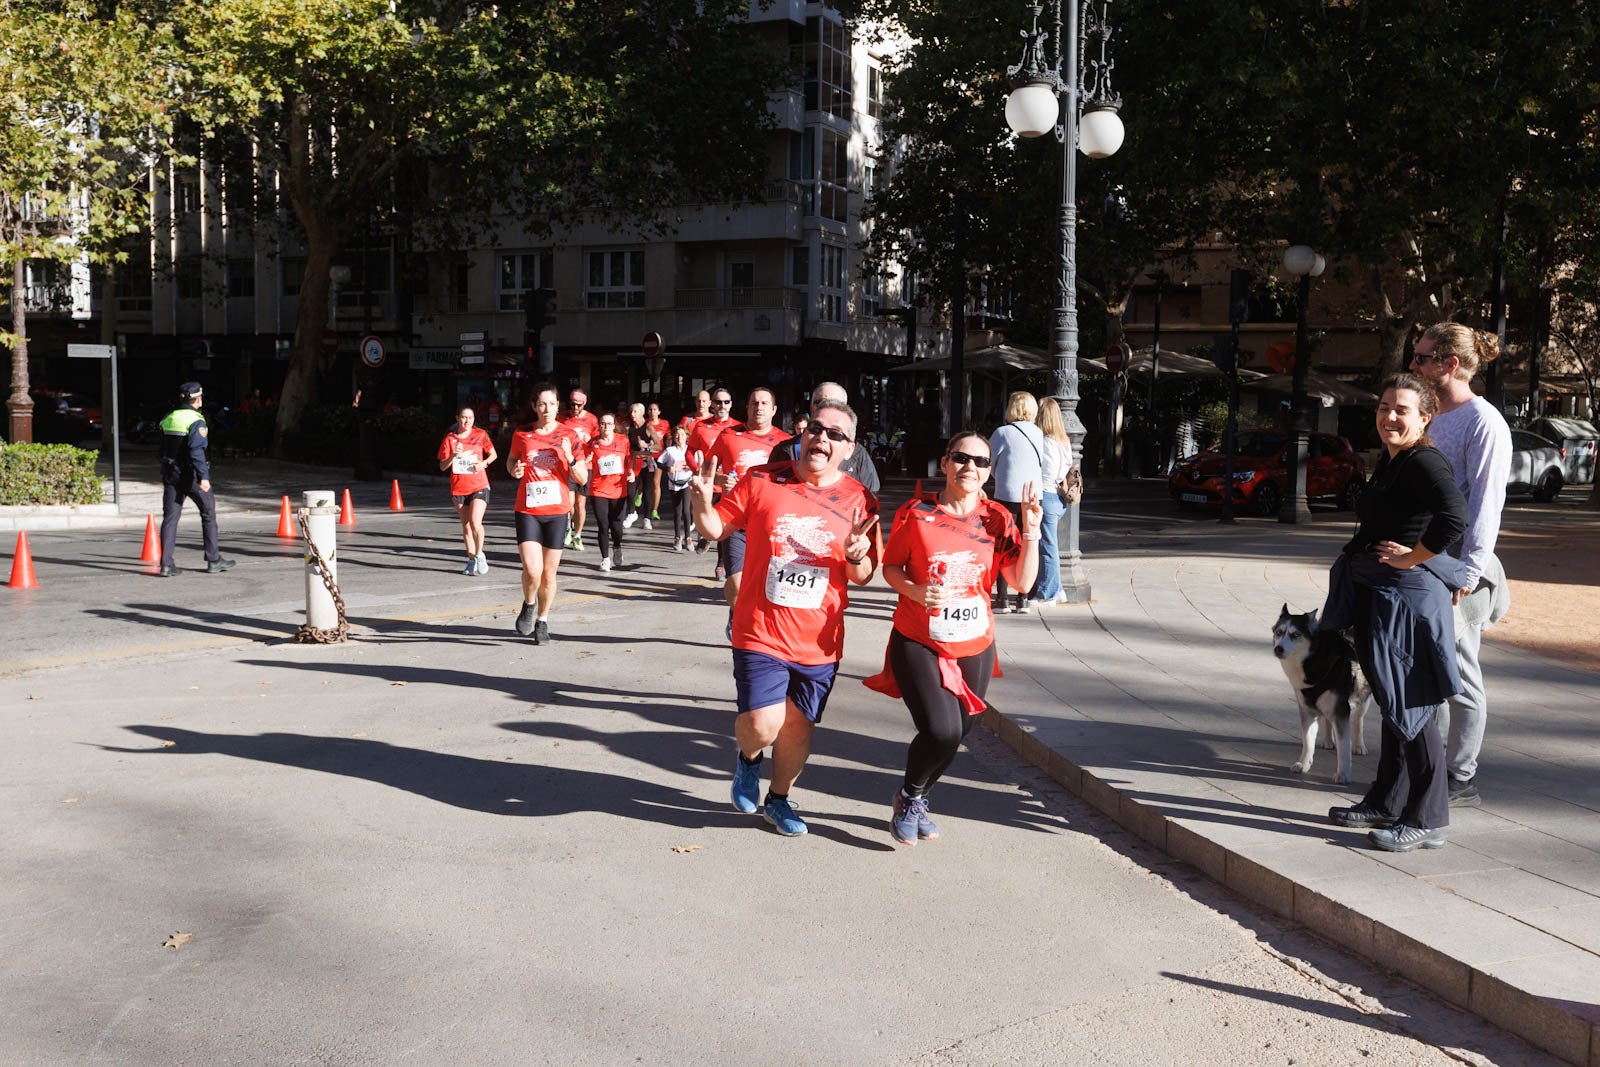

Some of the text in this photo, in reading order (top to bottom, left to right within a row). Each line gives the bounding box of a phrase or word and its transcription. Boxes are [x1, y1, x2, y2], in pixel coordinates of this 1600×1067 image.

[536, 486, 548, 495] 92
[776, 569, 816, 589] 1491
[943, 606, 978, 621] 1490
